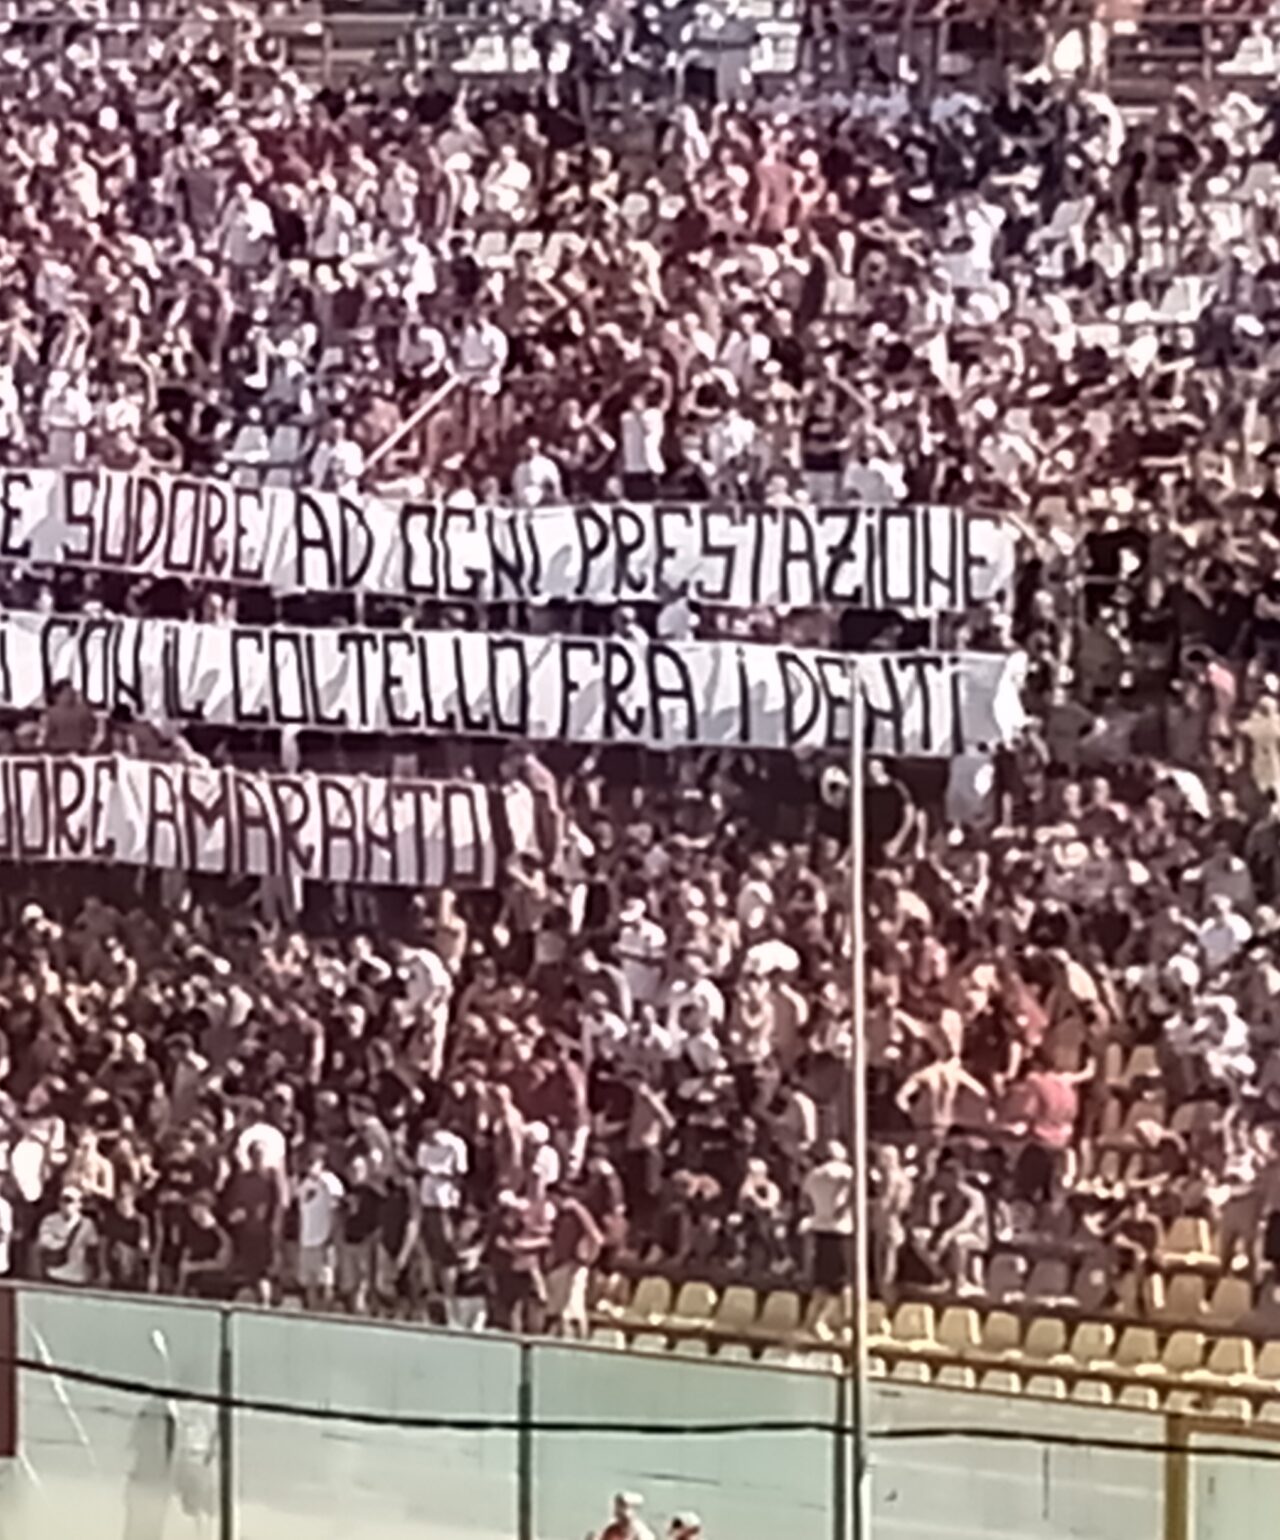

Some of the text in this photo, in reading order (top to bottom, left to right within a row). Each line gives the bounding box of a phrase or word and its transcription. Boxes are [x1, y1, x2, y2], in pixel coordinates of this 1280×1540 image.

[1, 471, 32, 557] E
[64, 470, 264, 580] SUDORE
[294, 493, 375, 589] AD
[230, 628, 531, 733] COLTELLO
[560, 640, 699, 739] FRA
